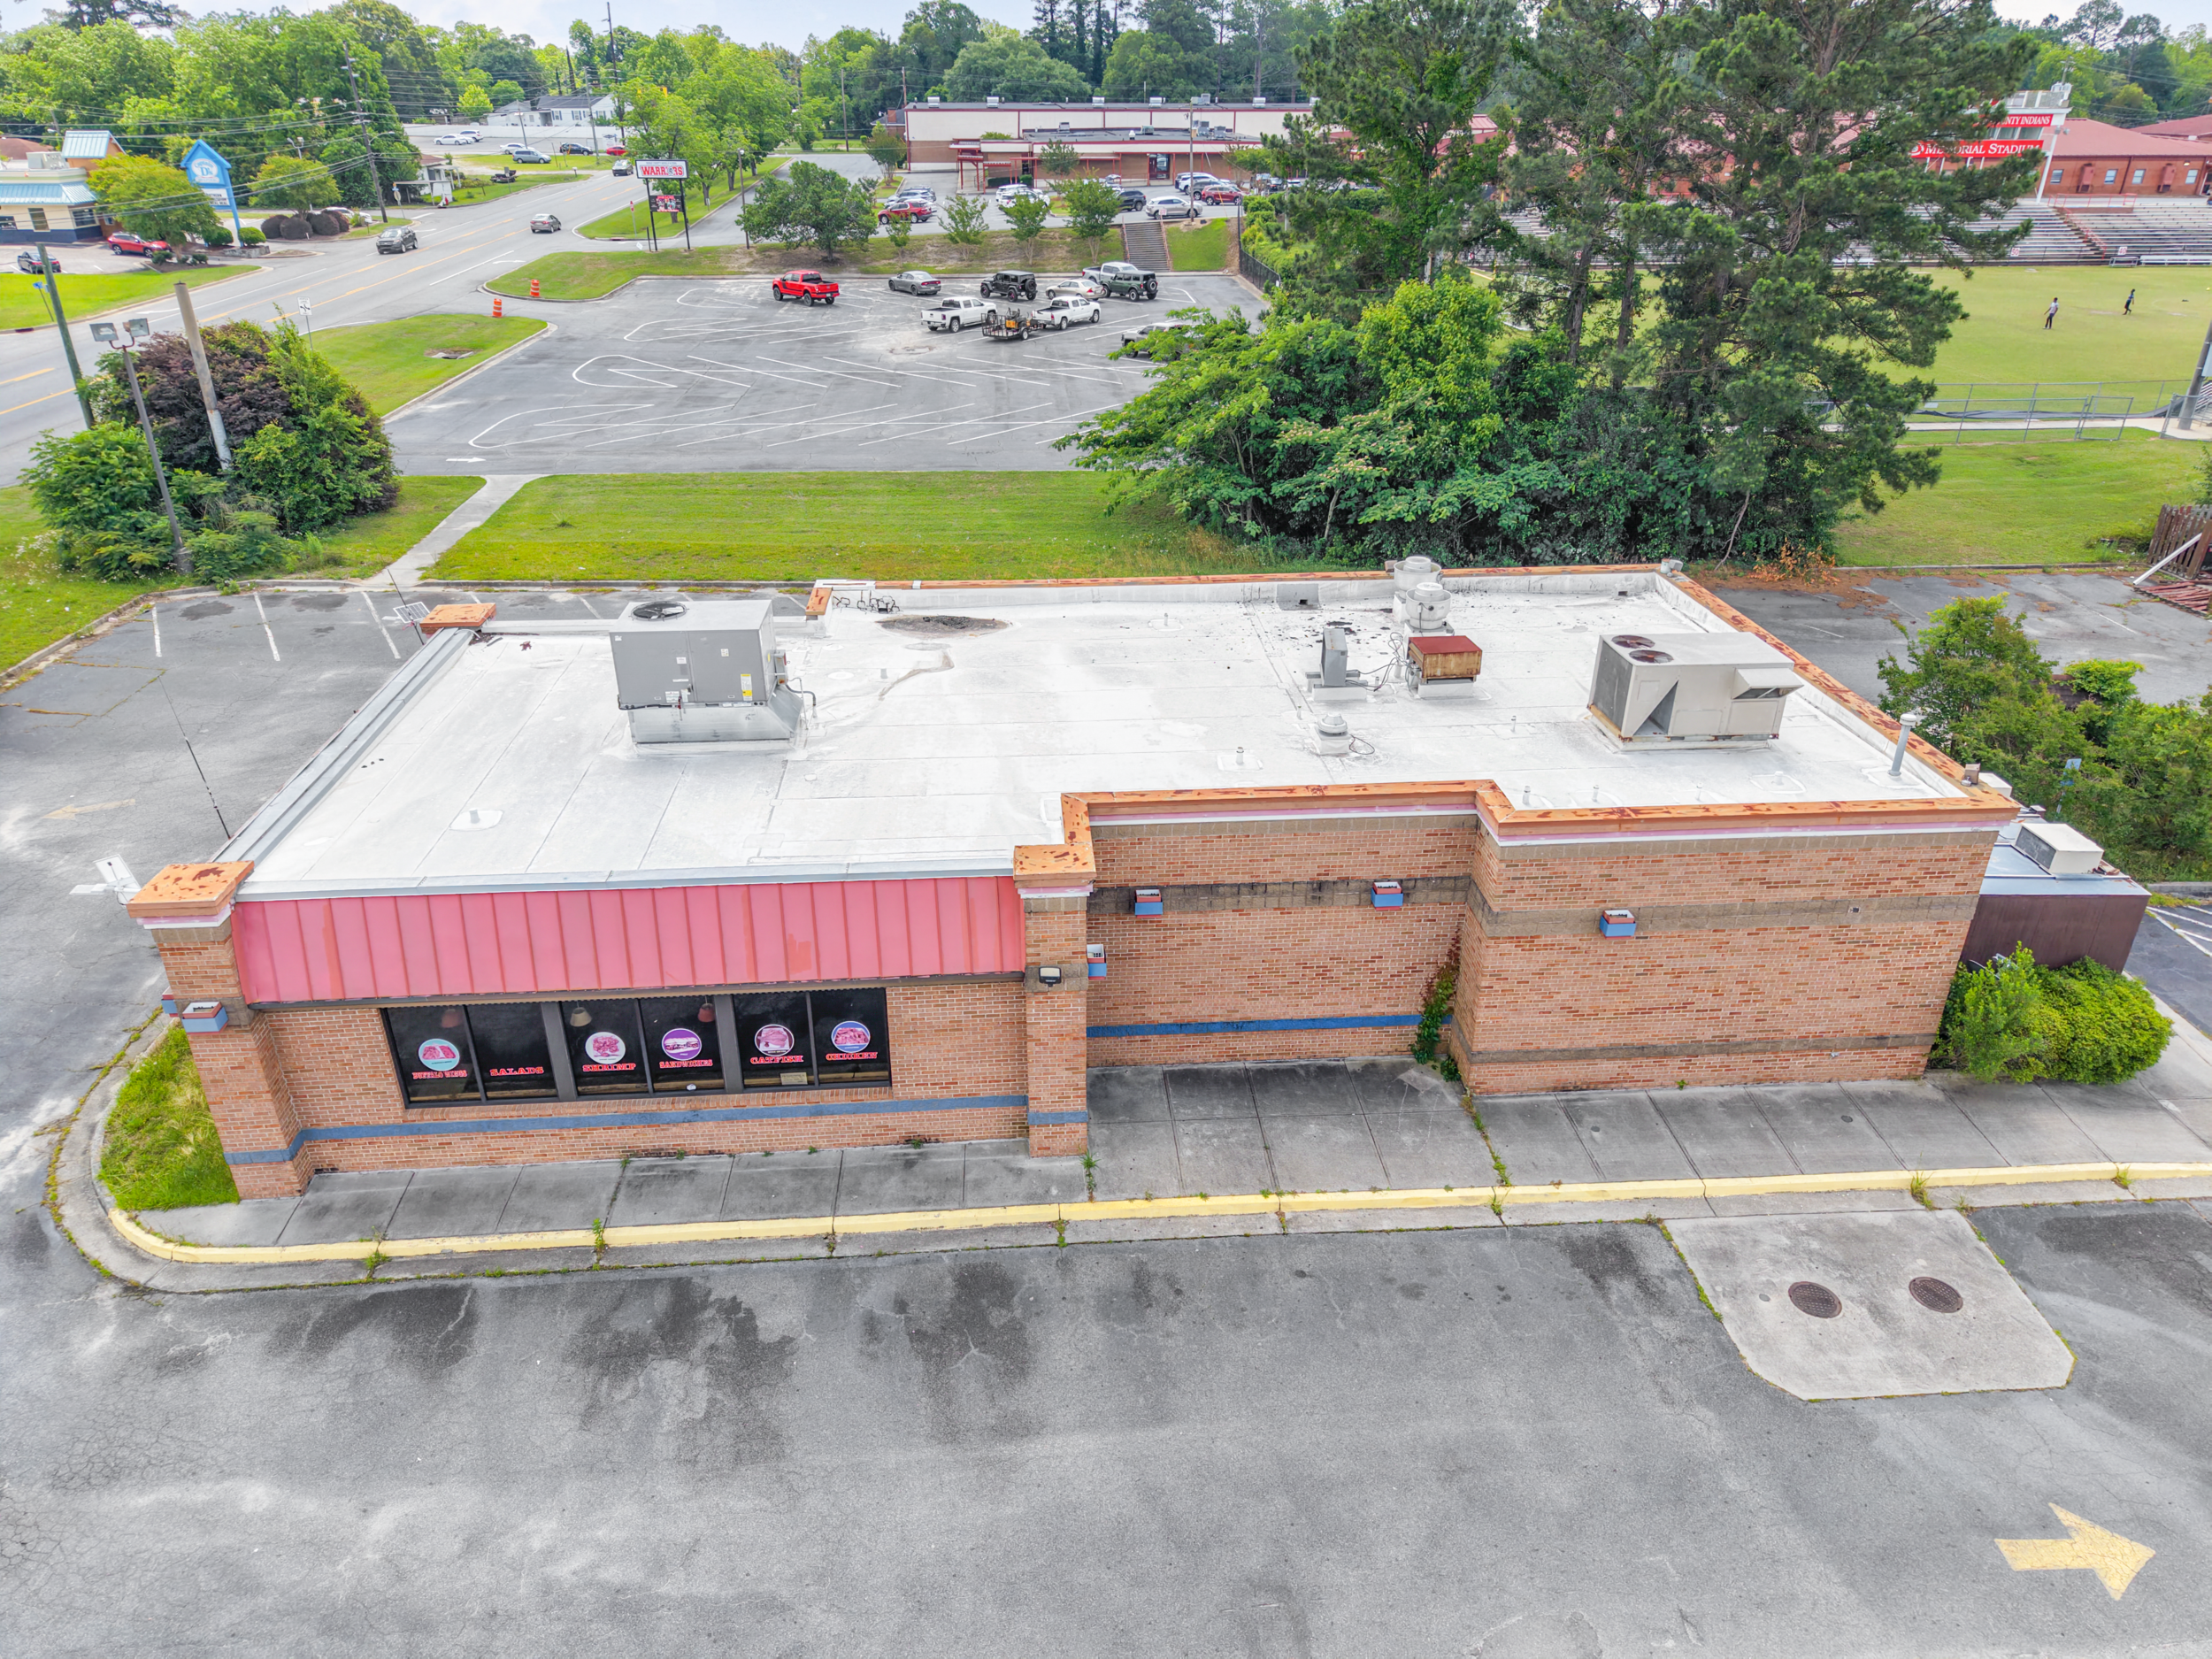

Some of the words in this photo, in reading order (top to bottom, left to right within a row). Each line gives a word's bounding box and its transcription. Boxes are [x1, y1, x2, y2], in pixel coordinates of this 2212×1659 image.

[2020, 116, 2051, 125] INDIANS
[1924, 143, 1986, 155] MEORIAL
[750, 1055, 804, 1064] CATFISH
[826, 1051, 879, 1061] CHICKEN
[582, 1063, 636, 1071] SHRIMP
[659, 1059, 713, 1069] SANDWICHES
[490, 1066, 544, 1076] SALADS
